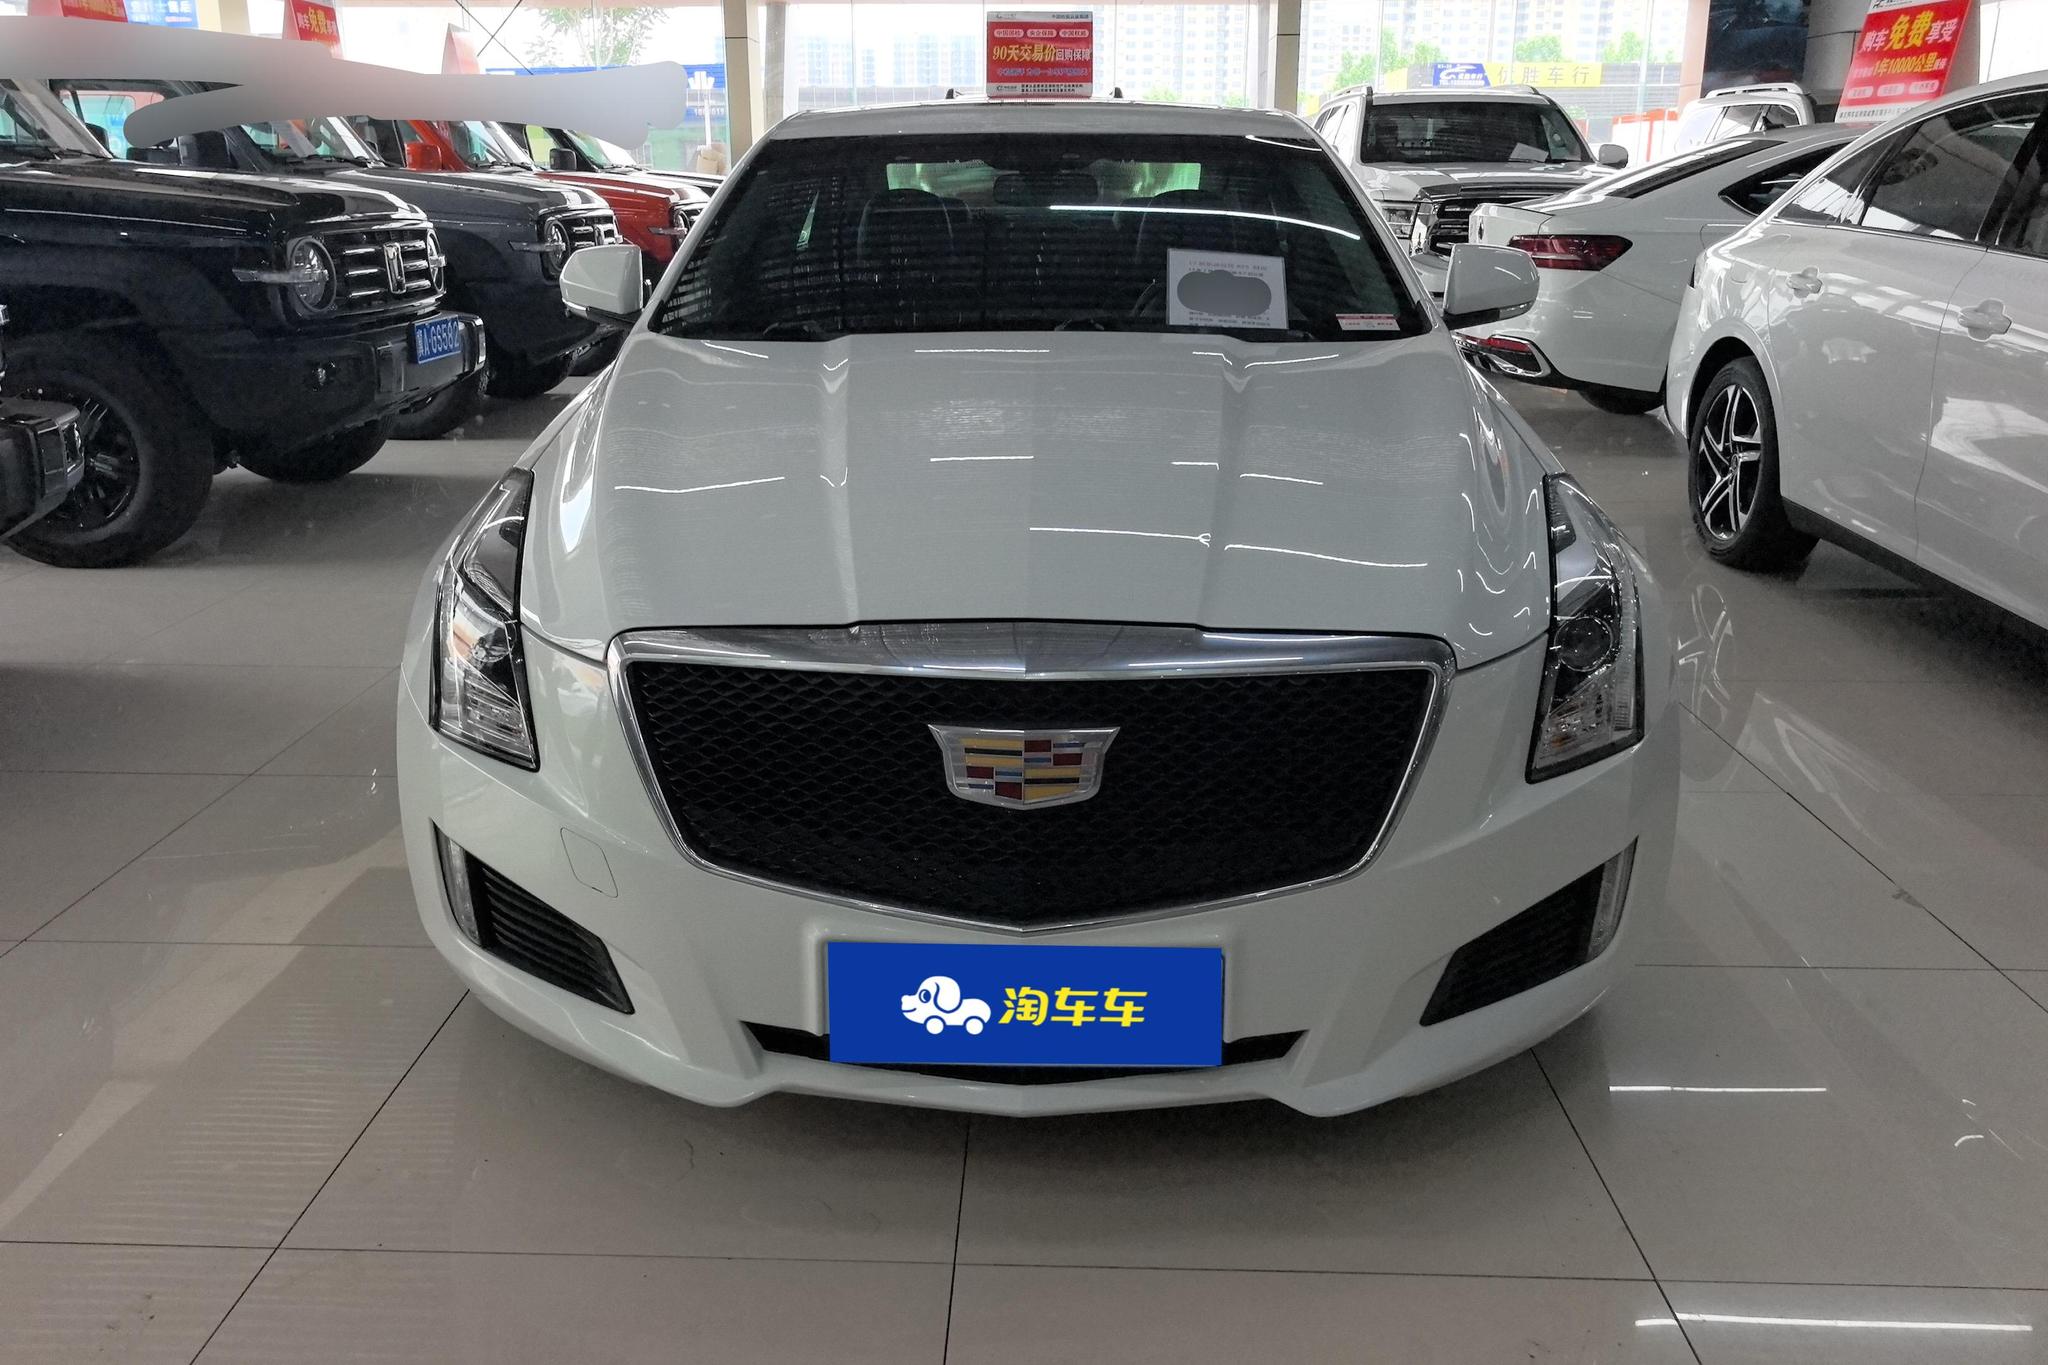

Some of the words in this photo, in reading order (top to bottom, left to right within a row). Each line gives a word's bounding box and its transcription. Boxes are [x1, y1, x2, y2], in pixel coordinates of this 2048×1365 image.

[1860, 10, 1958, 52] 购车免费享受
[992, 44, 1091, 62] 90天交易价回购保障
